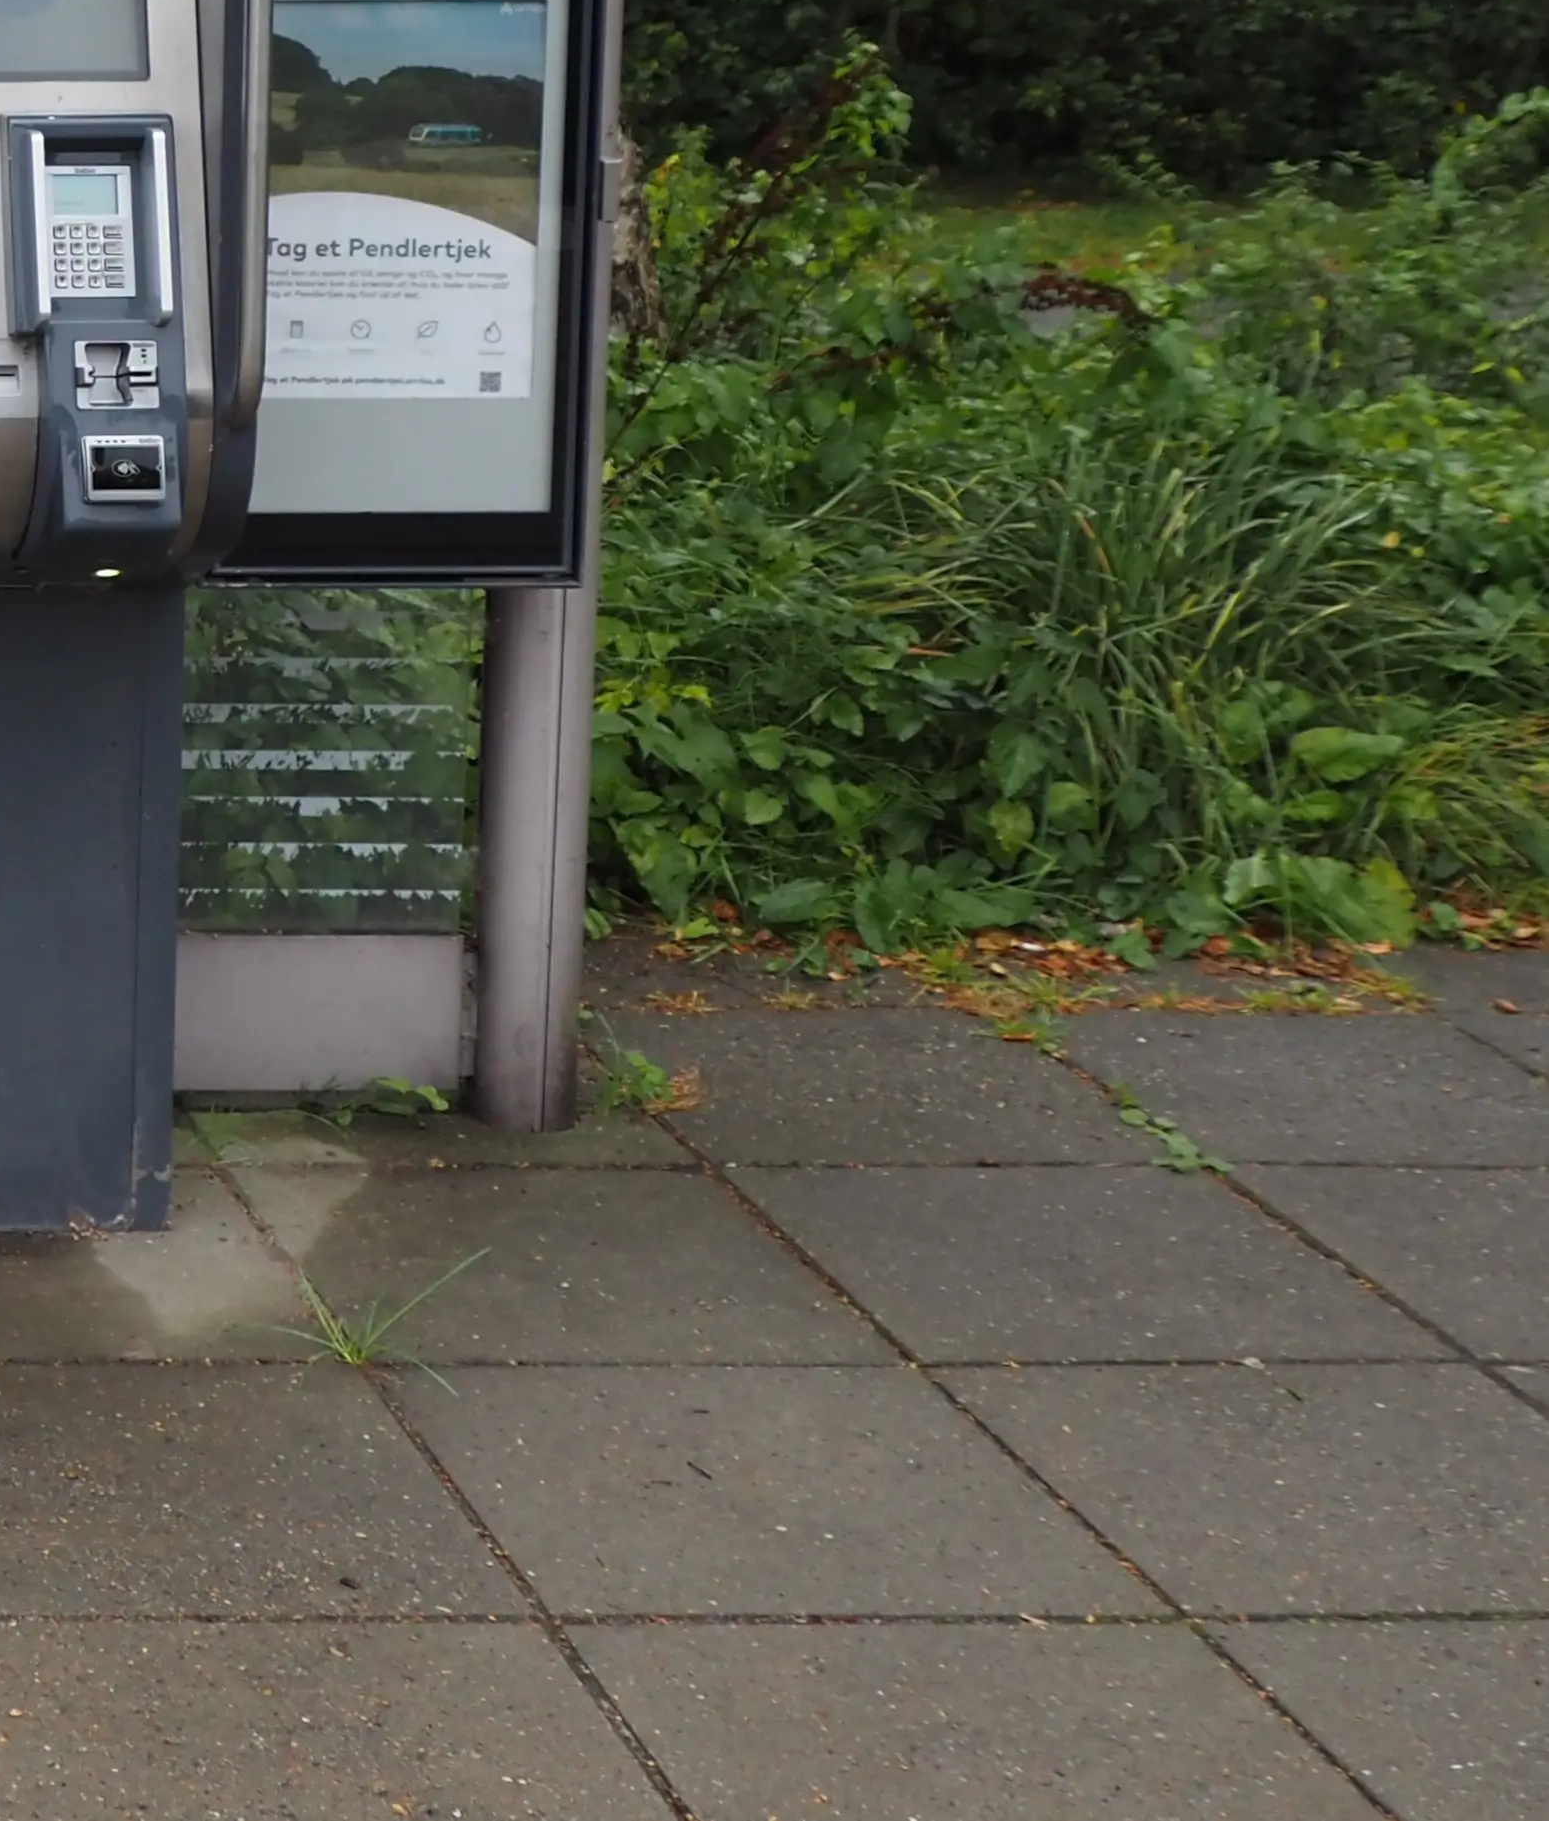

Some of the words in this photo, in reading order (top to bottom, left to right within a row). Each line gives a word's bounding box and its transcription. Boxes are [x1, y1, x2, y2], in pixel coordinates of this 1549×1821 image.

[266, 237, 307, 262] Tag
[314, 239, 342, 258] et
[348, 237, 492, 263] Pendlertjek
